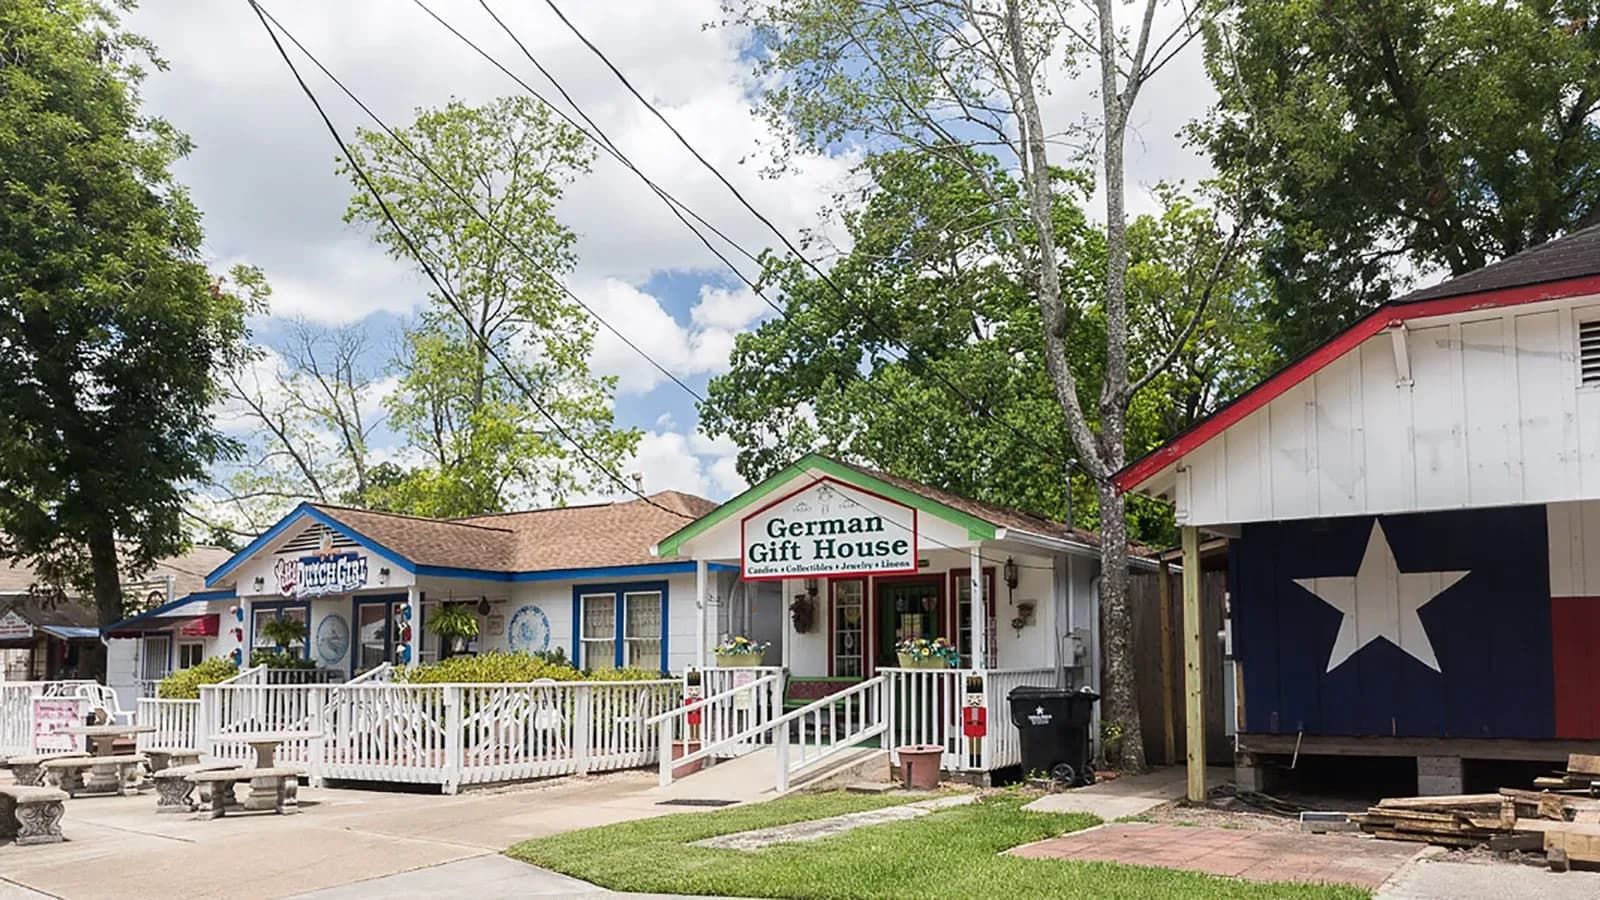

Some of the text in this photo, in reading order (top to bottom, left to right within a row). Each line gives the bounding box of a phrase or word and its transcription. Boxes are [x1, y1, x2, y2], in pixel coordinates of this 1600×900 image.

[767, 516, 884, 538] German
[749, 538, 909, 563] Gift House
[296, 561, 337, 588] DUTCH
[337, 556, 368, 587] GIRL
[748, 559, 910, 575] Candies Collectibles Jewelry Linens
